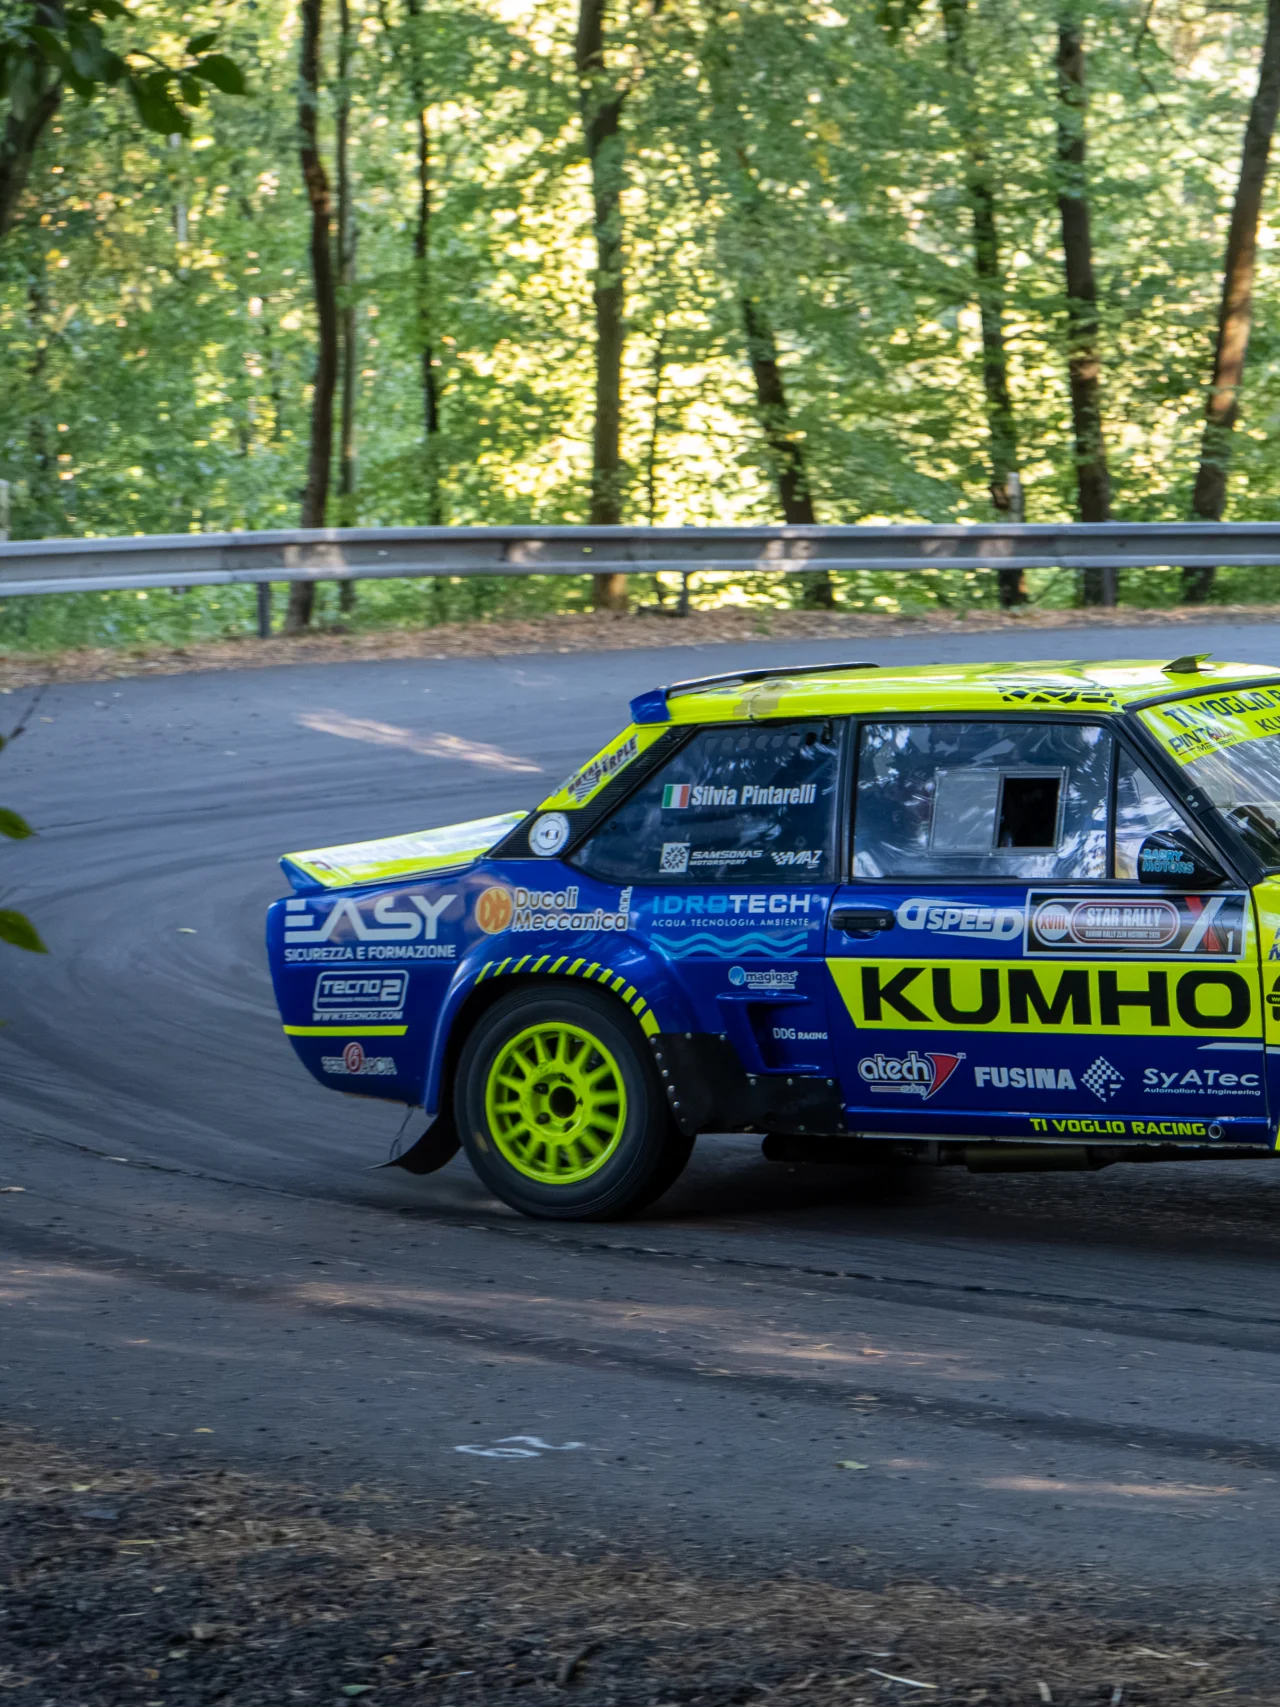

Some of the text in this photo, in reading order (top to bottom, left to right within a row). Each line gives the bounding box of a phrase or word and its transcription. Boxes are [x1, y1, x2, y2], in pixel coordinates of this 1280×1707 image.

[1162, 707, 1198, 728] TI
[1188, 690, 1276, 720] VOGLIO
[690, 784, 817, 806] Silvia Pintarelli
[689, 858, 748, 866] MOTORSPORT
[691, 850, 764, 860] SAMSONAS
[1142, 860, 1195, 874] MOTORS
[515, 886, 579, 910] Ducoli
[284, 894, 458, 943] EASY
[513, 908, 629, 932] Meccanica
[1086, 908, 1163, 928] STAR RALLY
[284, 945, 457, 962] SICUREZZA E FORMAZIONE
[861, 966, 1252, 1030] KUMHO
[772, 1027, 828, 1040] DDG RACING
[858, 1051, 933, 1081] atech
[974, 1066, 1077, 1090] FUSINA
[1143, 1087, 1197, 1095] Automation
[1207, 1088, 1262, 1097] Engineering
[1030, 1118, 1207, 1137] TI VOGLIO RACING
